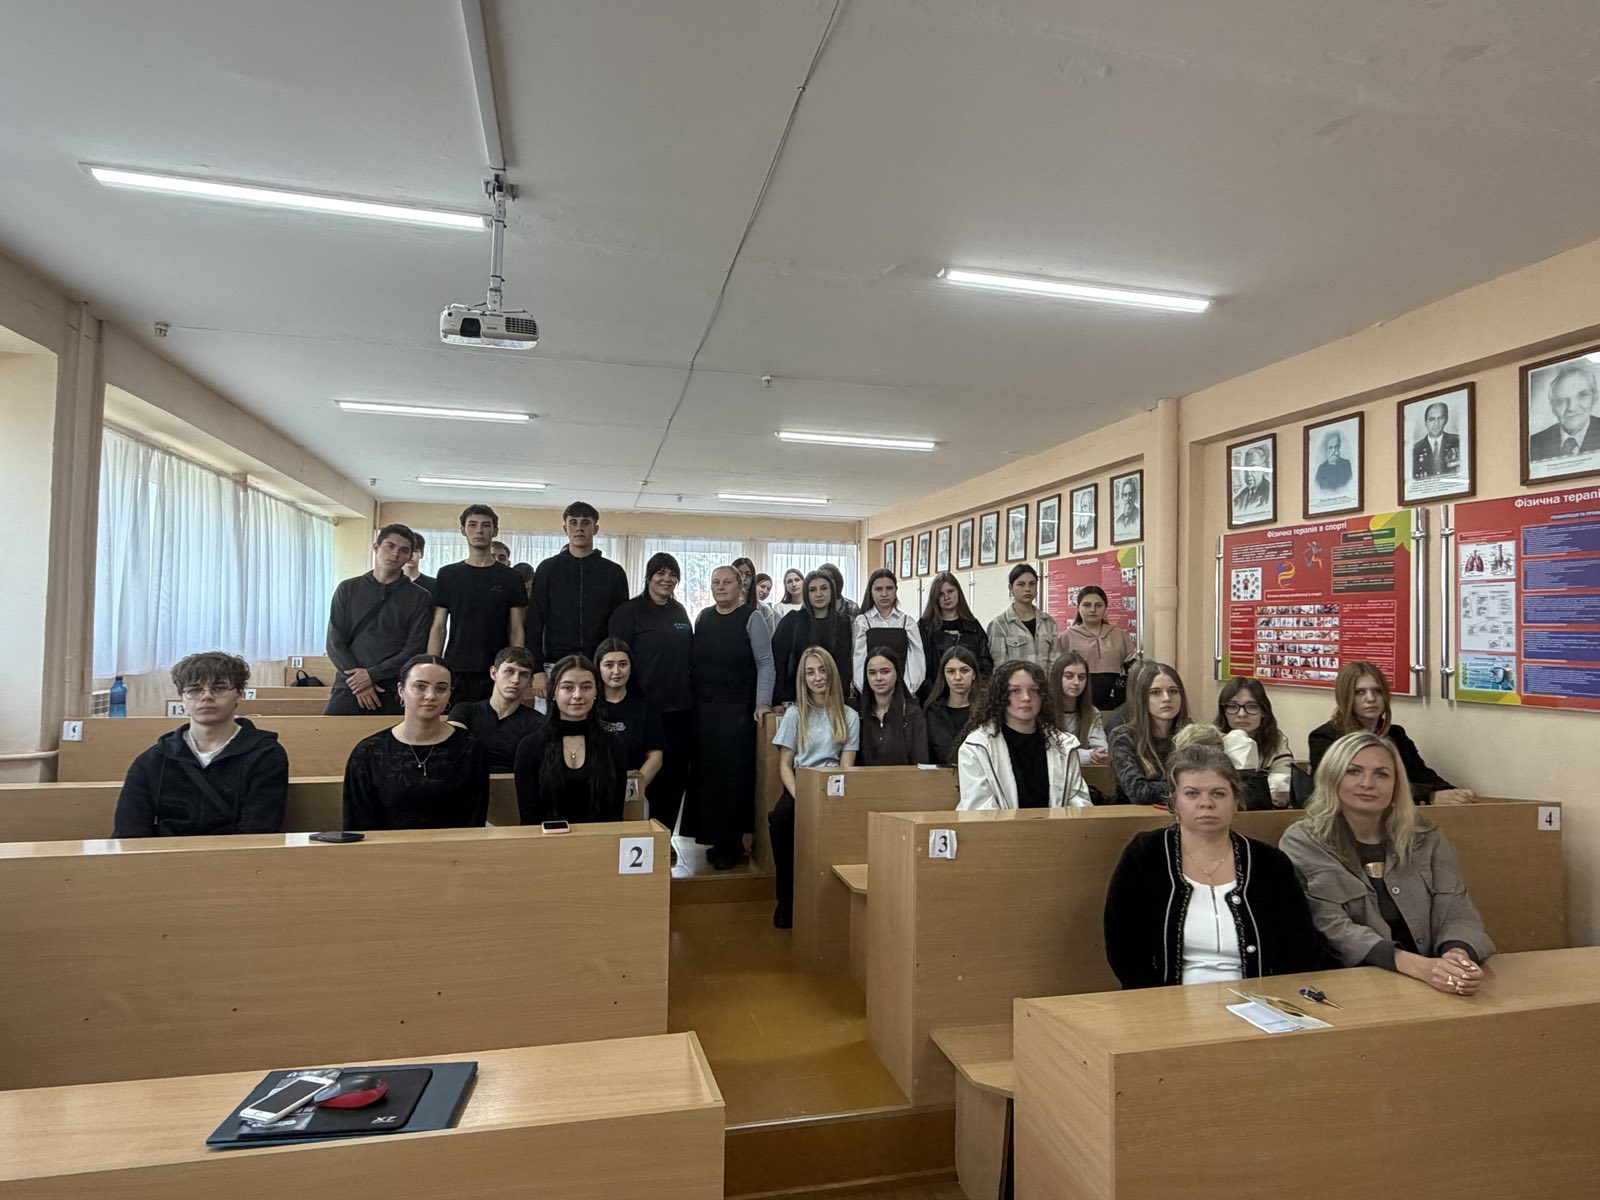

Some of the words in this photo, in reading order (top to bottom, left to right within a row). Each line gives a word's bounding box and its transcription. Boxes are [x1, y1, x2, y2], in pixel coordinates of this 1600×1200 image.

[1514, 495, 1560, 508] Фізична
[1563, 489, 1600, 503] терапі
[1266, 528, 1292, 538] Фізична
[1293, 525, 1318, 536] терапія
[1325, 521, 1347, 531] спорті
[172, 705, 185, 715] 13
[834, 779, 841, 793] 7
[1545, 811, 1553, 827] 4
[938, 835, 948, 853] 3
[629, 845, 644, 868] 2
